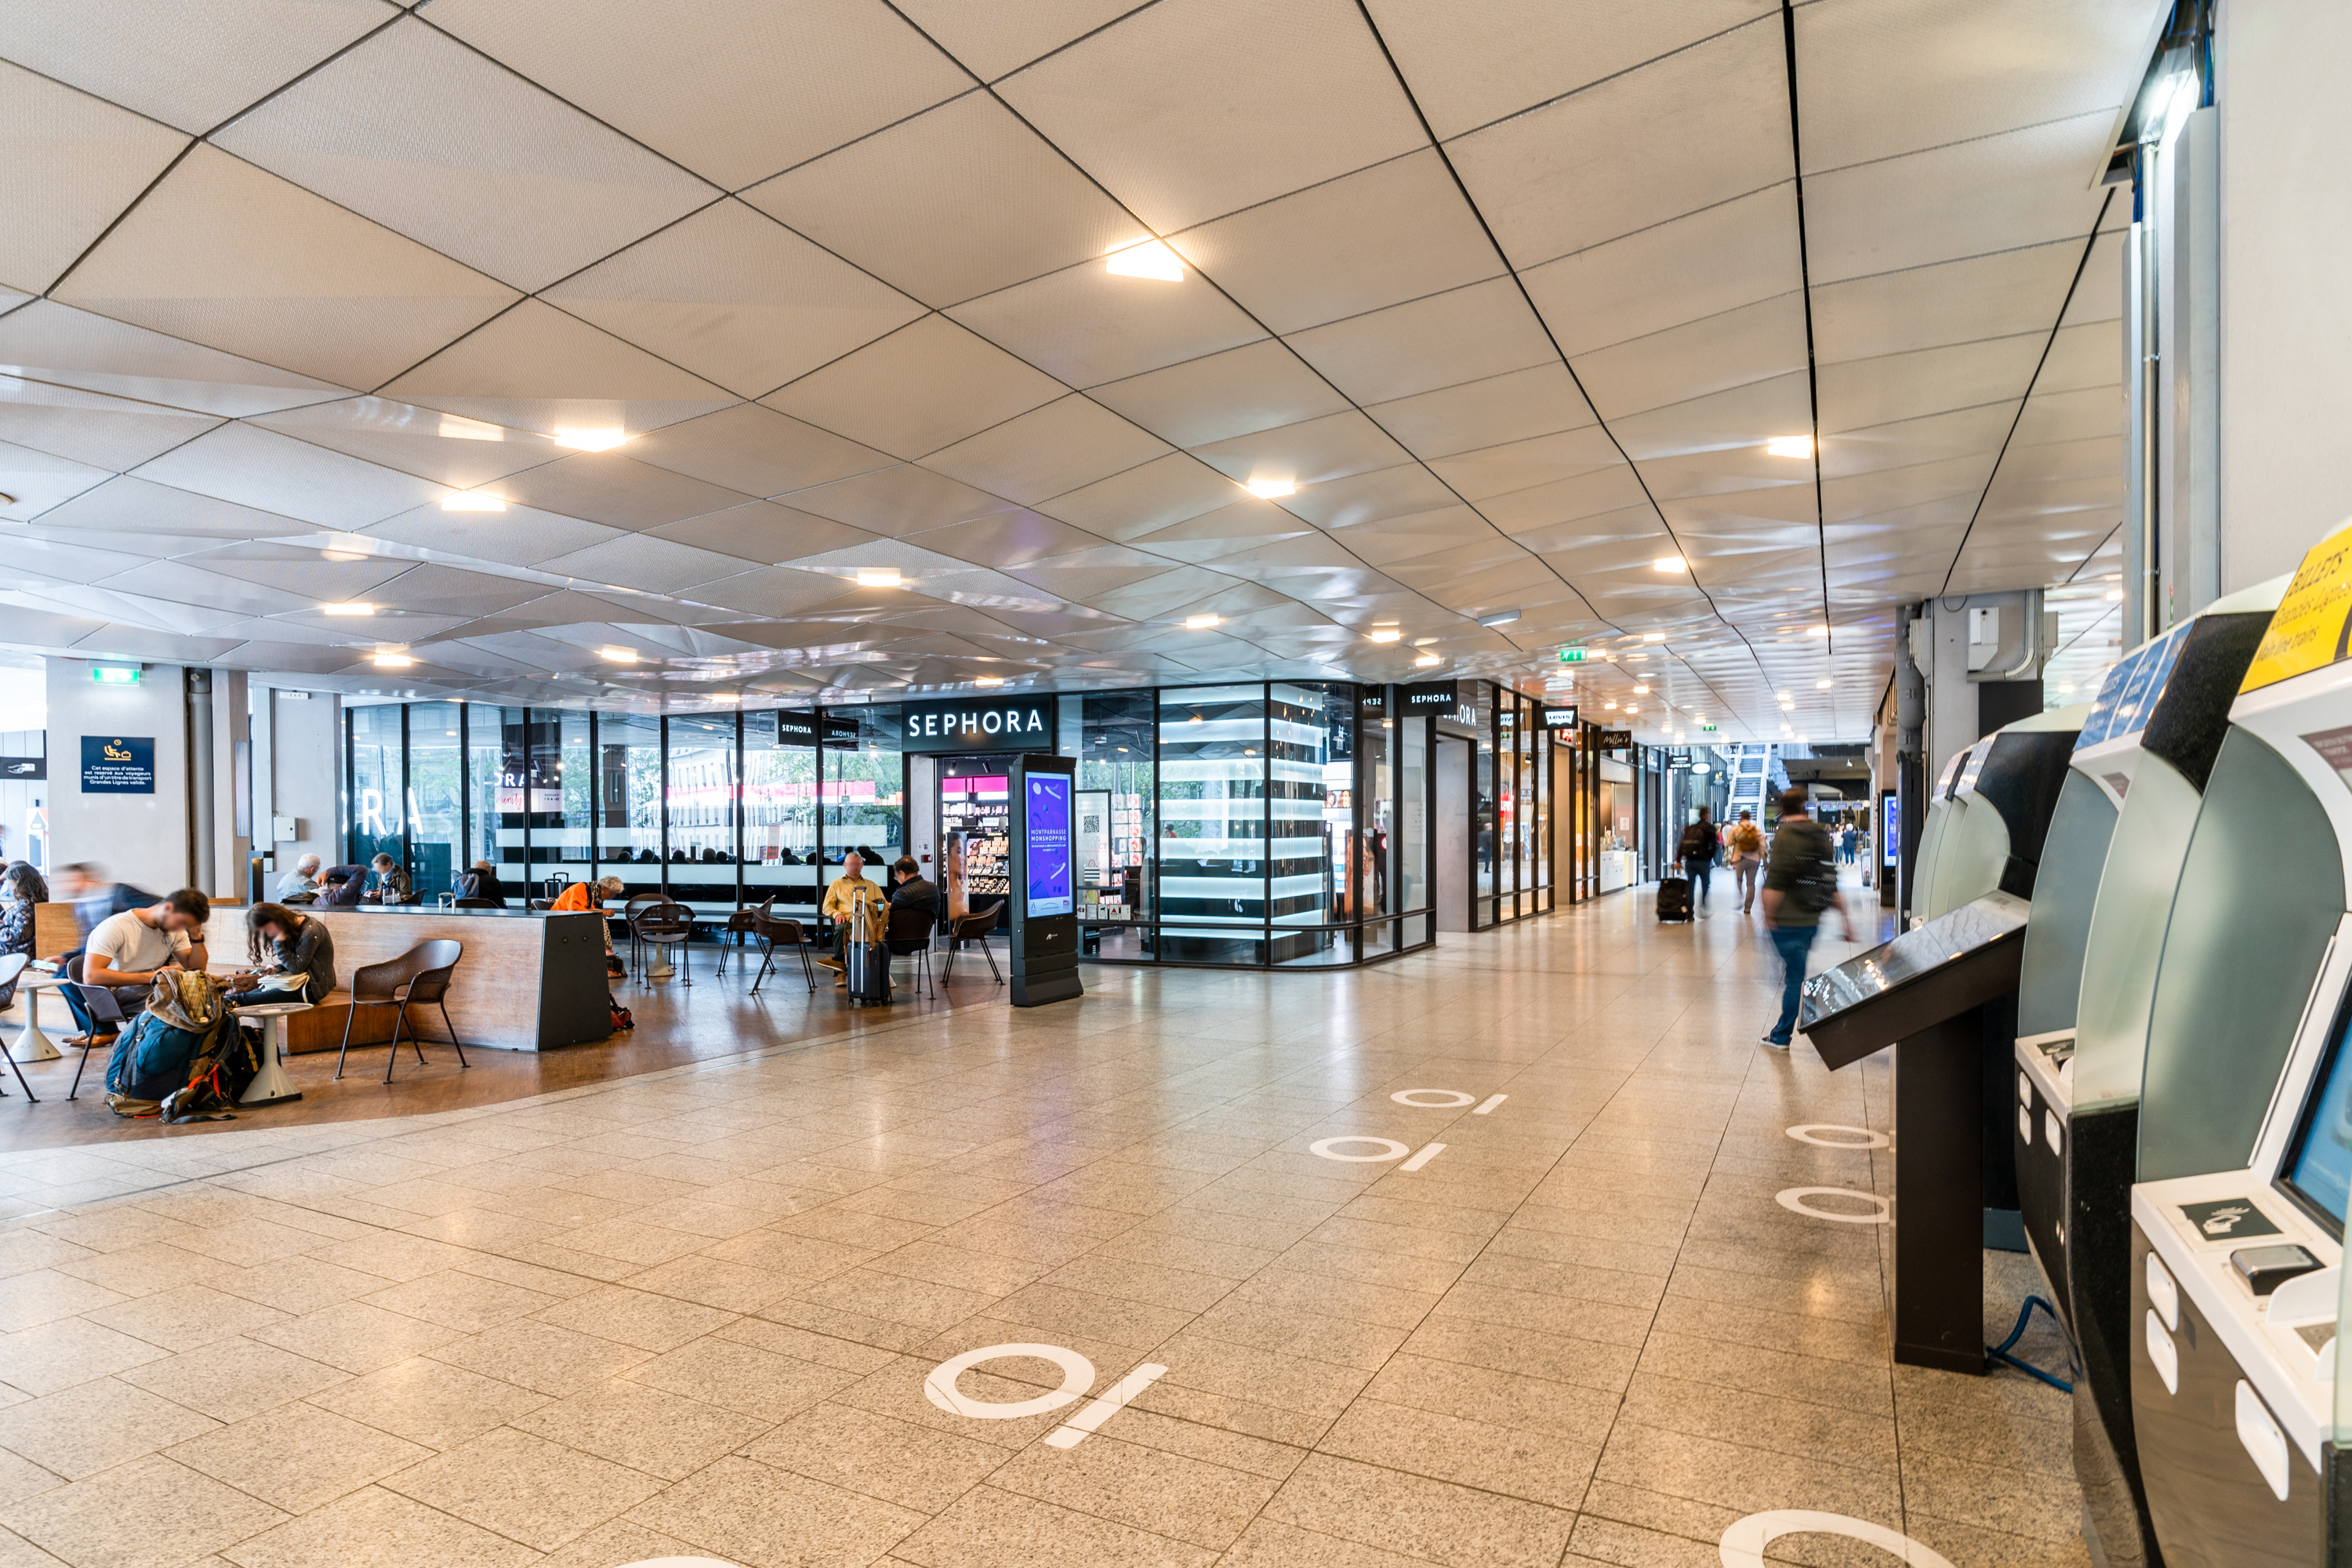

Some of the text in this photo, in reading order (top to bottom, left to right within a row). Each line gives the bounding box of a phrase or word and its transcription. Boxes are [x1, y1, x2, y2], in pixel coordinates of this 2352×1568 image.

[2287, 546, 2350, 598] BILLETS
[1411, 694, 1451, 703] SEPHORA
[782, 724, 811, 734] SEPHORA
[909, 709, 1043, 737] SEPHORA
[1603, 733, 1629, 745] Millie's
